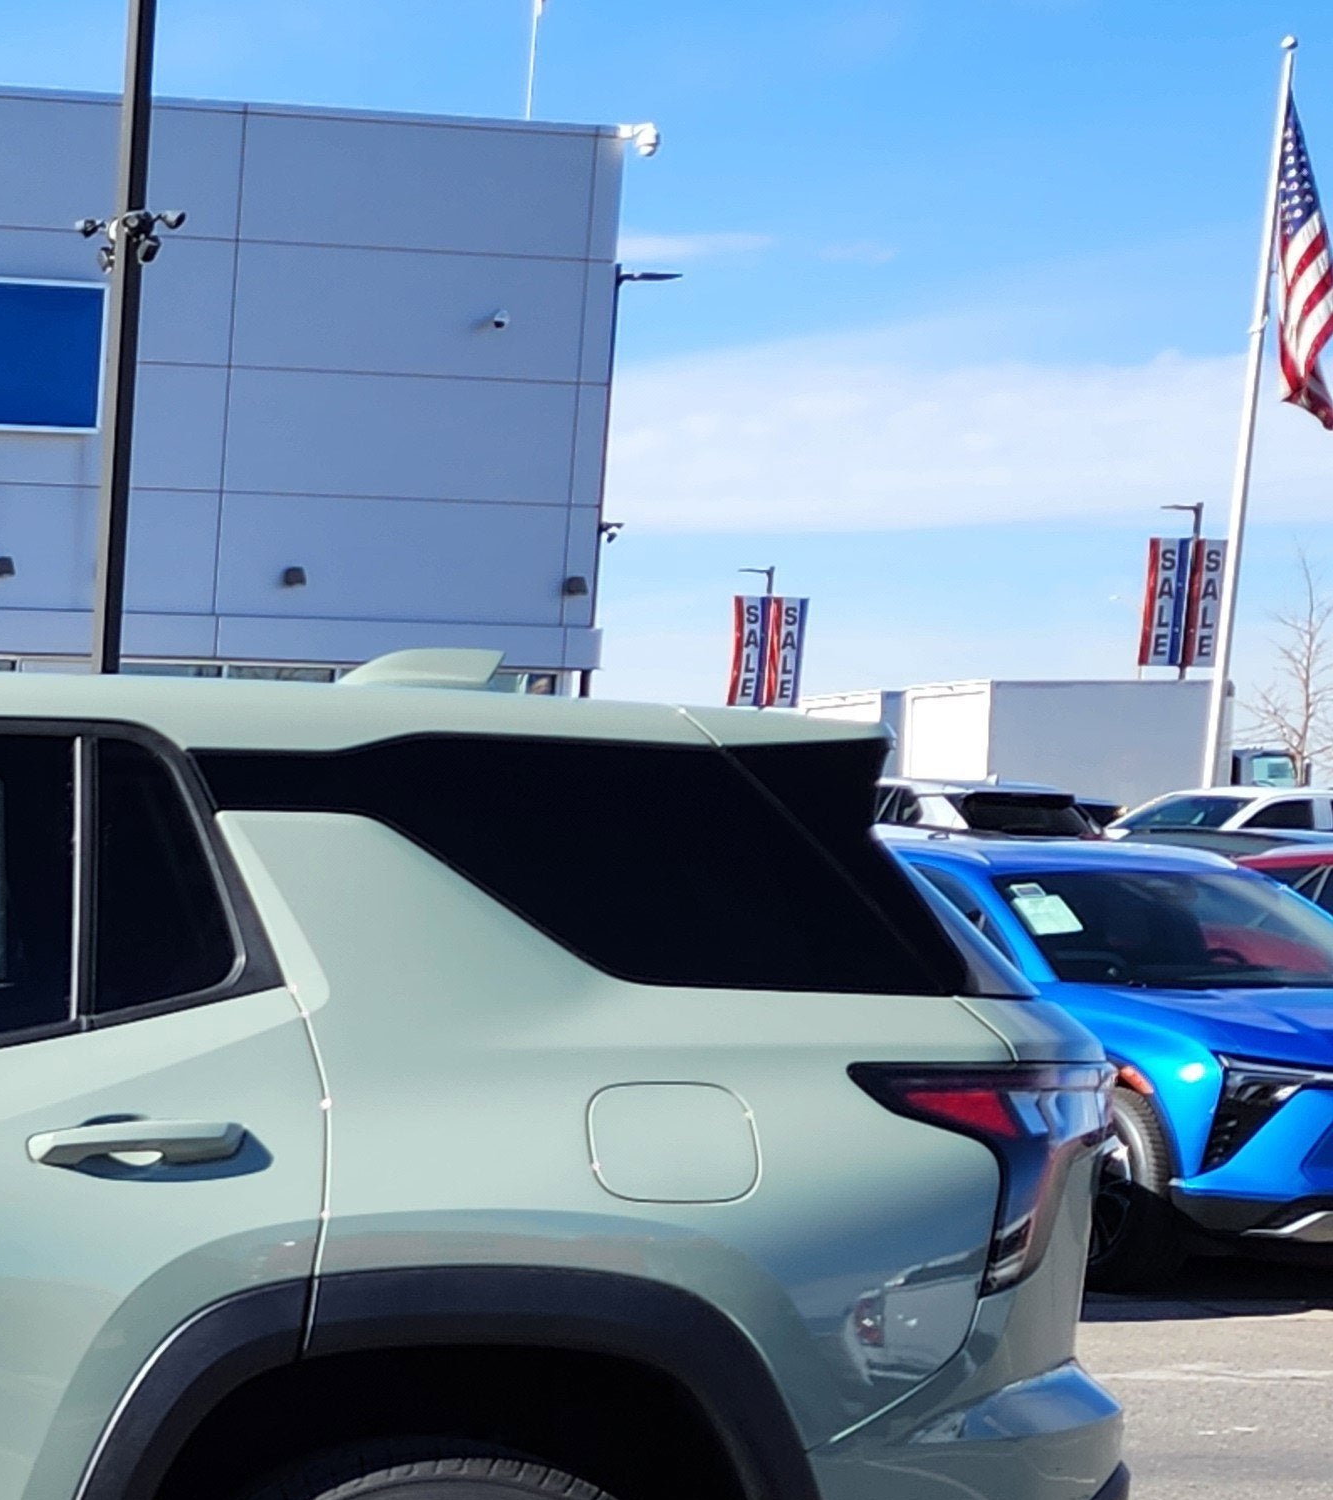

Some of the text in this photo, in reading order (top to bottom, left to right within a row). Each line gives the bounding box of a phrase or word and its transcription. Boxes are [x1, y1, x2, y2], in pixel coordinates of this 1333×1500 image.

[740, 604, 760, 698] SALE
[778, 606, 798, 699] SALE
[1153, 548, 1177, 656] SALE
[1197, 549, 1222, 657] SALE
